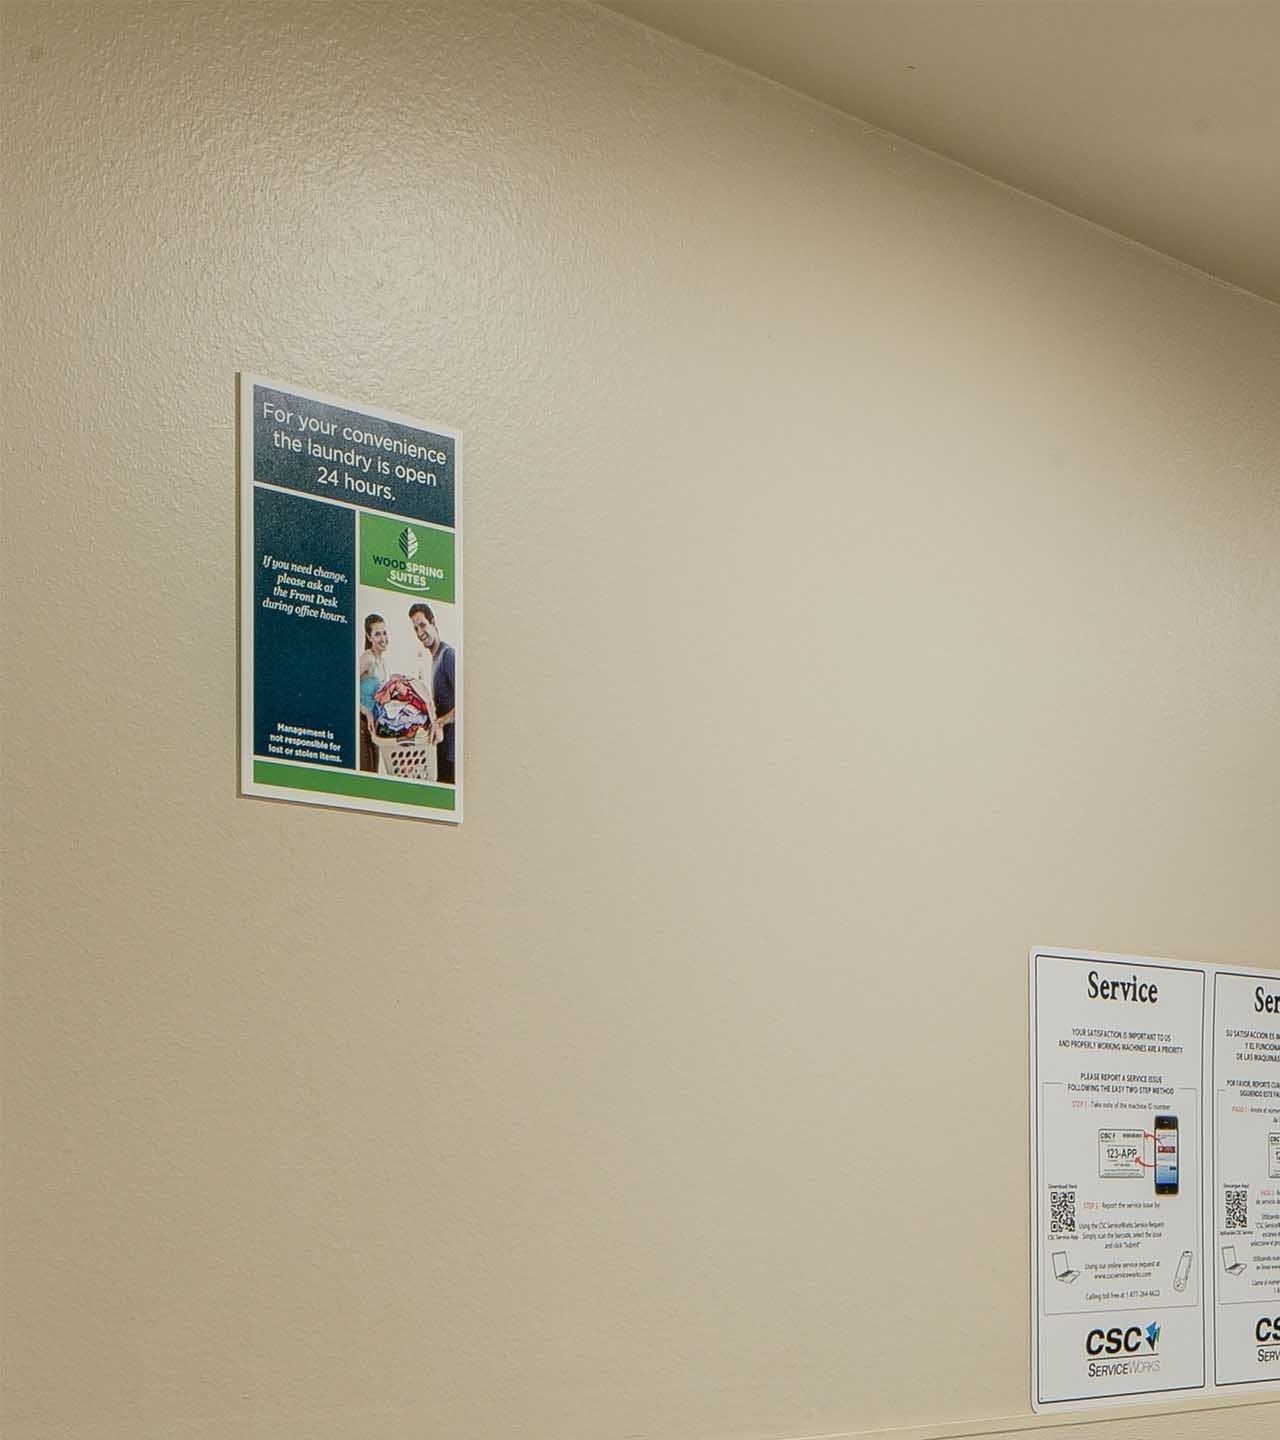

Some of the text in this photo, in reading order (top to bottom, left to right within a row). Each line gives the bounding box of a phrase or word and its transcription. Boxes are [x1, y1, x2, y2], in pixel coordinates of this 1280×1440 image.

[263, 402, 447, 465] For your convenience
[273, 431, 437, 486] the laundry is open
[318, 467, 396, 500] 24 hours.
[263, 555, 348, 583] If you need change,
[373, 555, 444, 579] WOODSPRING
[277, 572, 333, 593] please ask at
[390, 570, 426, 586] SUITES
[273, 586, 338, 608] the Front Desk
[262, 598, 348, 623] during office hours.
[277, 723, 334, 739] Management is
[268, 744, 283, 754] lost
[285, 747, 293, 755] or
[295, 749, 318, 759] stolen
[270, 734, 341, 751] not responsible for
[1088, 971, 1158, 1003] Service
[1072, 1028, 1171, 1042] YOUR SATISFACTION IMPORTANT TO US
[1059, 1040, 1070, 1048] AND
[1071, 1040, 1096, 1049] PROPERLY
[1098, 1042, 1120, 1050] WORKING
[1122, 1043, 1146, 1052] MACHINES
[1148, 1045, 1157, 1053] ARE
[1244, 1053, 1253, 1061] LAS
[1081, 1072, 1162, 1083] PLEASE REPORT SERVICE ISSUE
[1068, 1083, 1099, 1092] FOLLOWING
[1101, 1084, 1110, 1093] THE
[1112, 1085, 1125, 1093] EASY
[1152, 1087, 1174, 1095] METHOD
[1107, 1148, 1137, 1158] 123-APP
[1086, 1326, 1142, 1355] CSC
